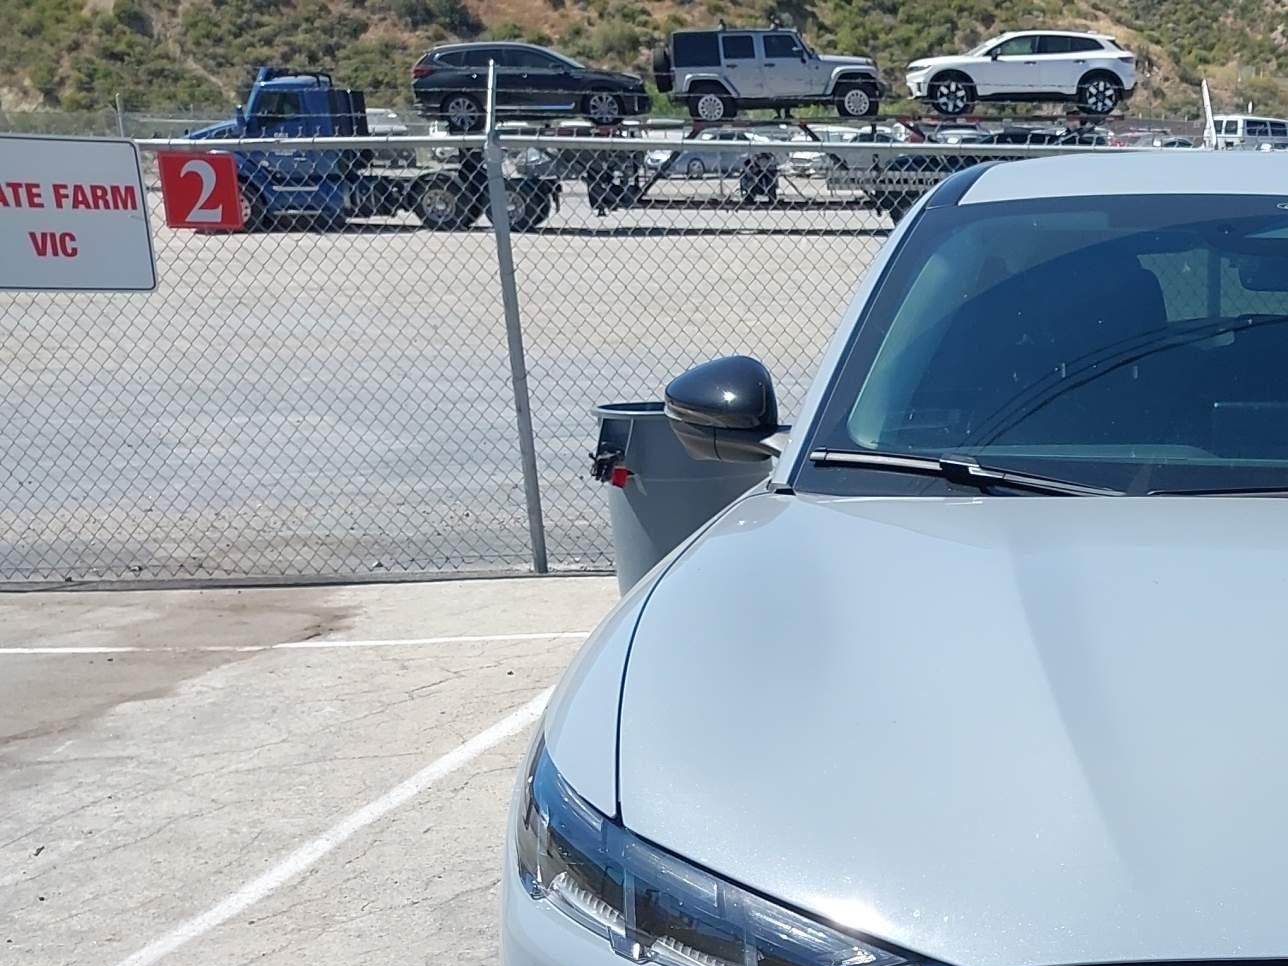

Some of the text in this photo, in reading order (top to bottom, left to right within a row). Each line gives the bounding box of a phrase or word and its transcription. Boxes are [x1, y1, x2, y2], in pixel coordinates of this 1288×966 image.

[52, 184, 137, 210] FARM
[179, 159, 223, 223] 2
[28, 231, 78, 257] VIC
